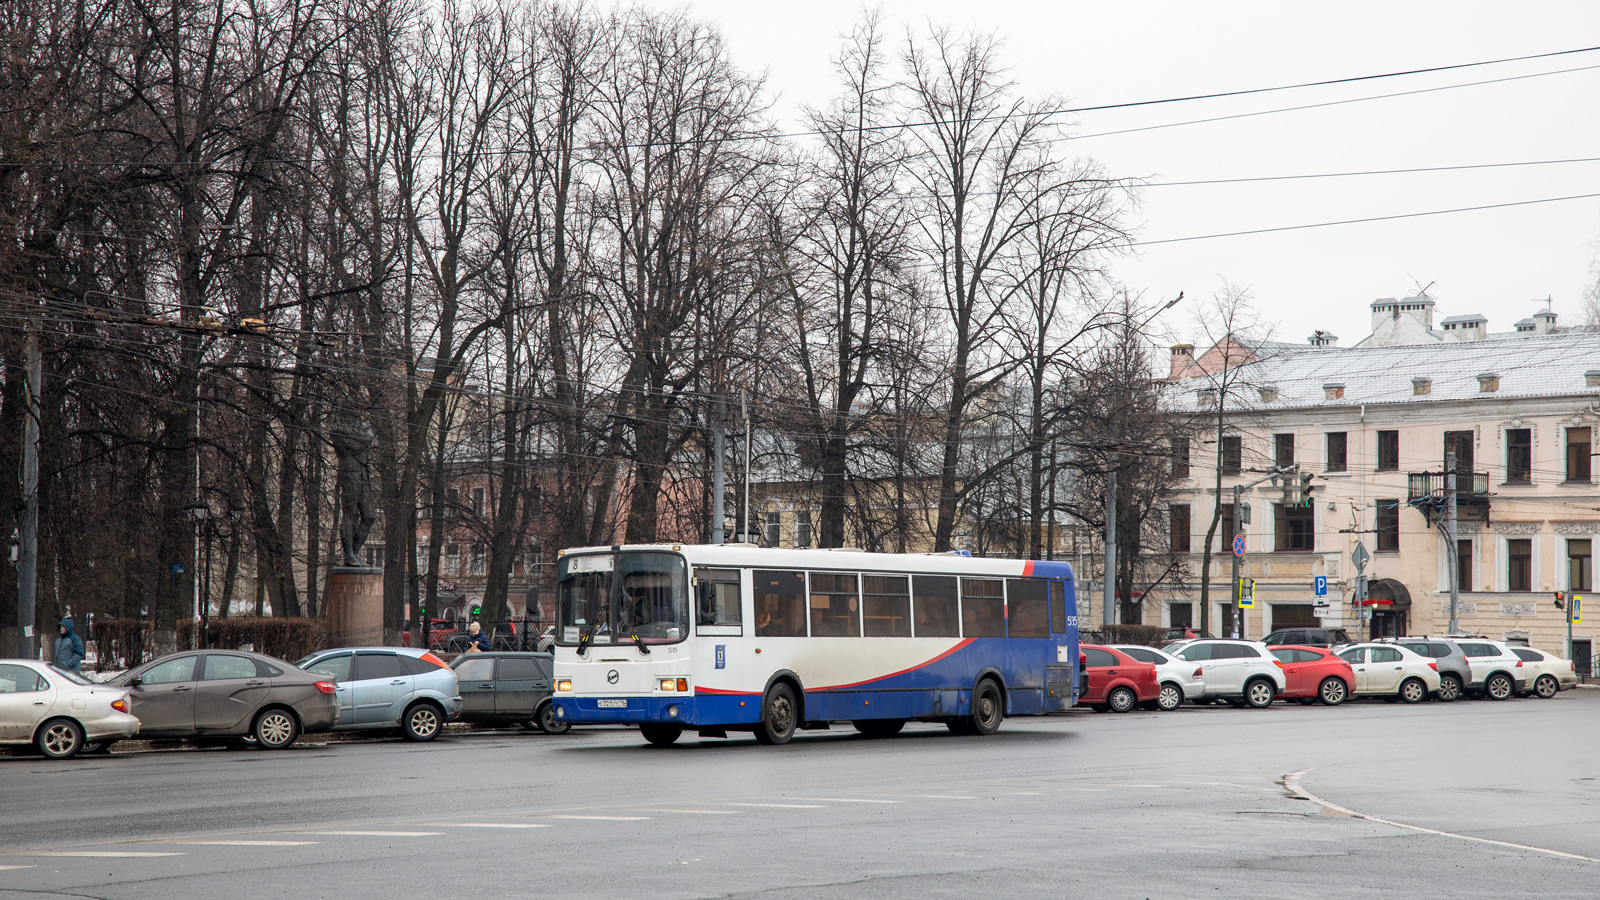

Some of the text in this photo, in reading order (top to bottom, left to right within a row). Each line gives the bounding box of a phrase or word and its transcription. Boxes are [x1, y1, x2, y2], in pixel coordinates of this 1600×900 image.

[573, 558, 578, 570] 8
[1318, 578, 1325, 593] P
[1067, 616, 1078, 626] 535
